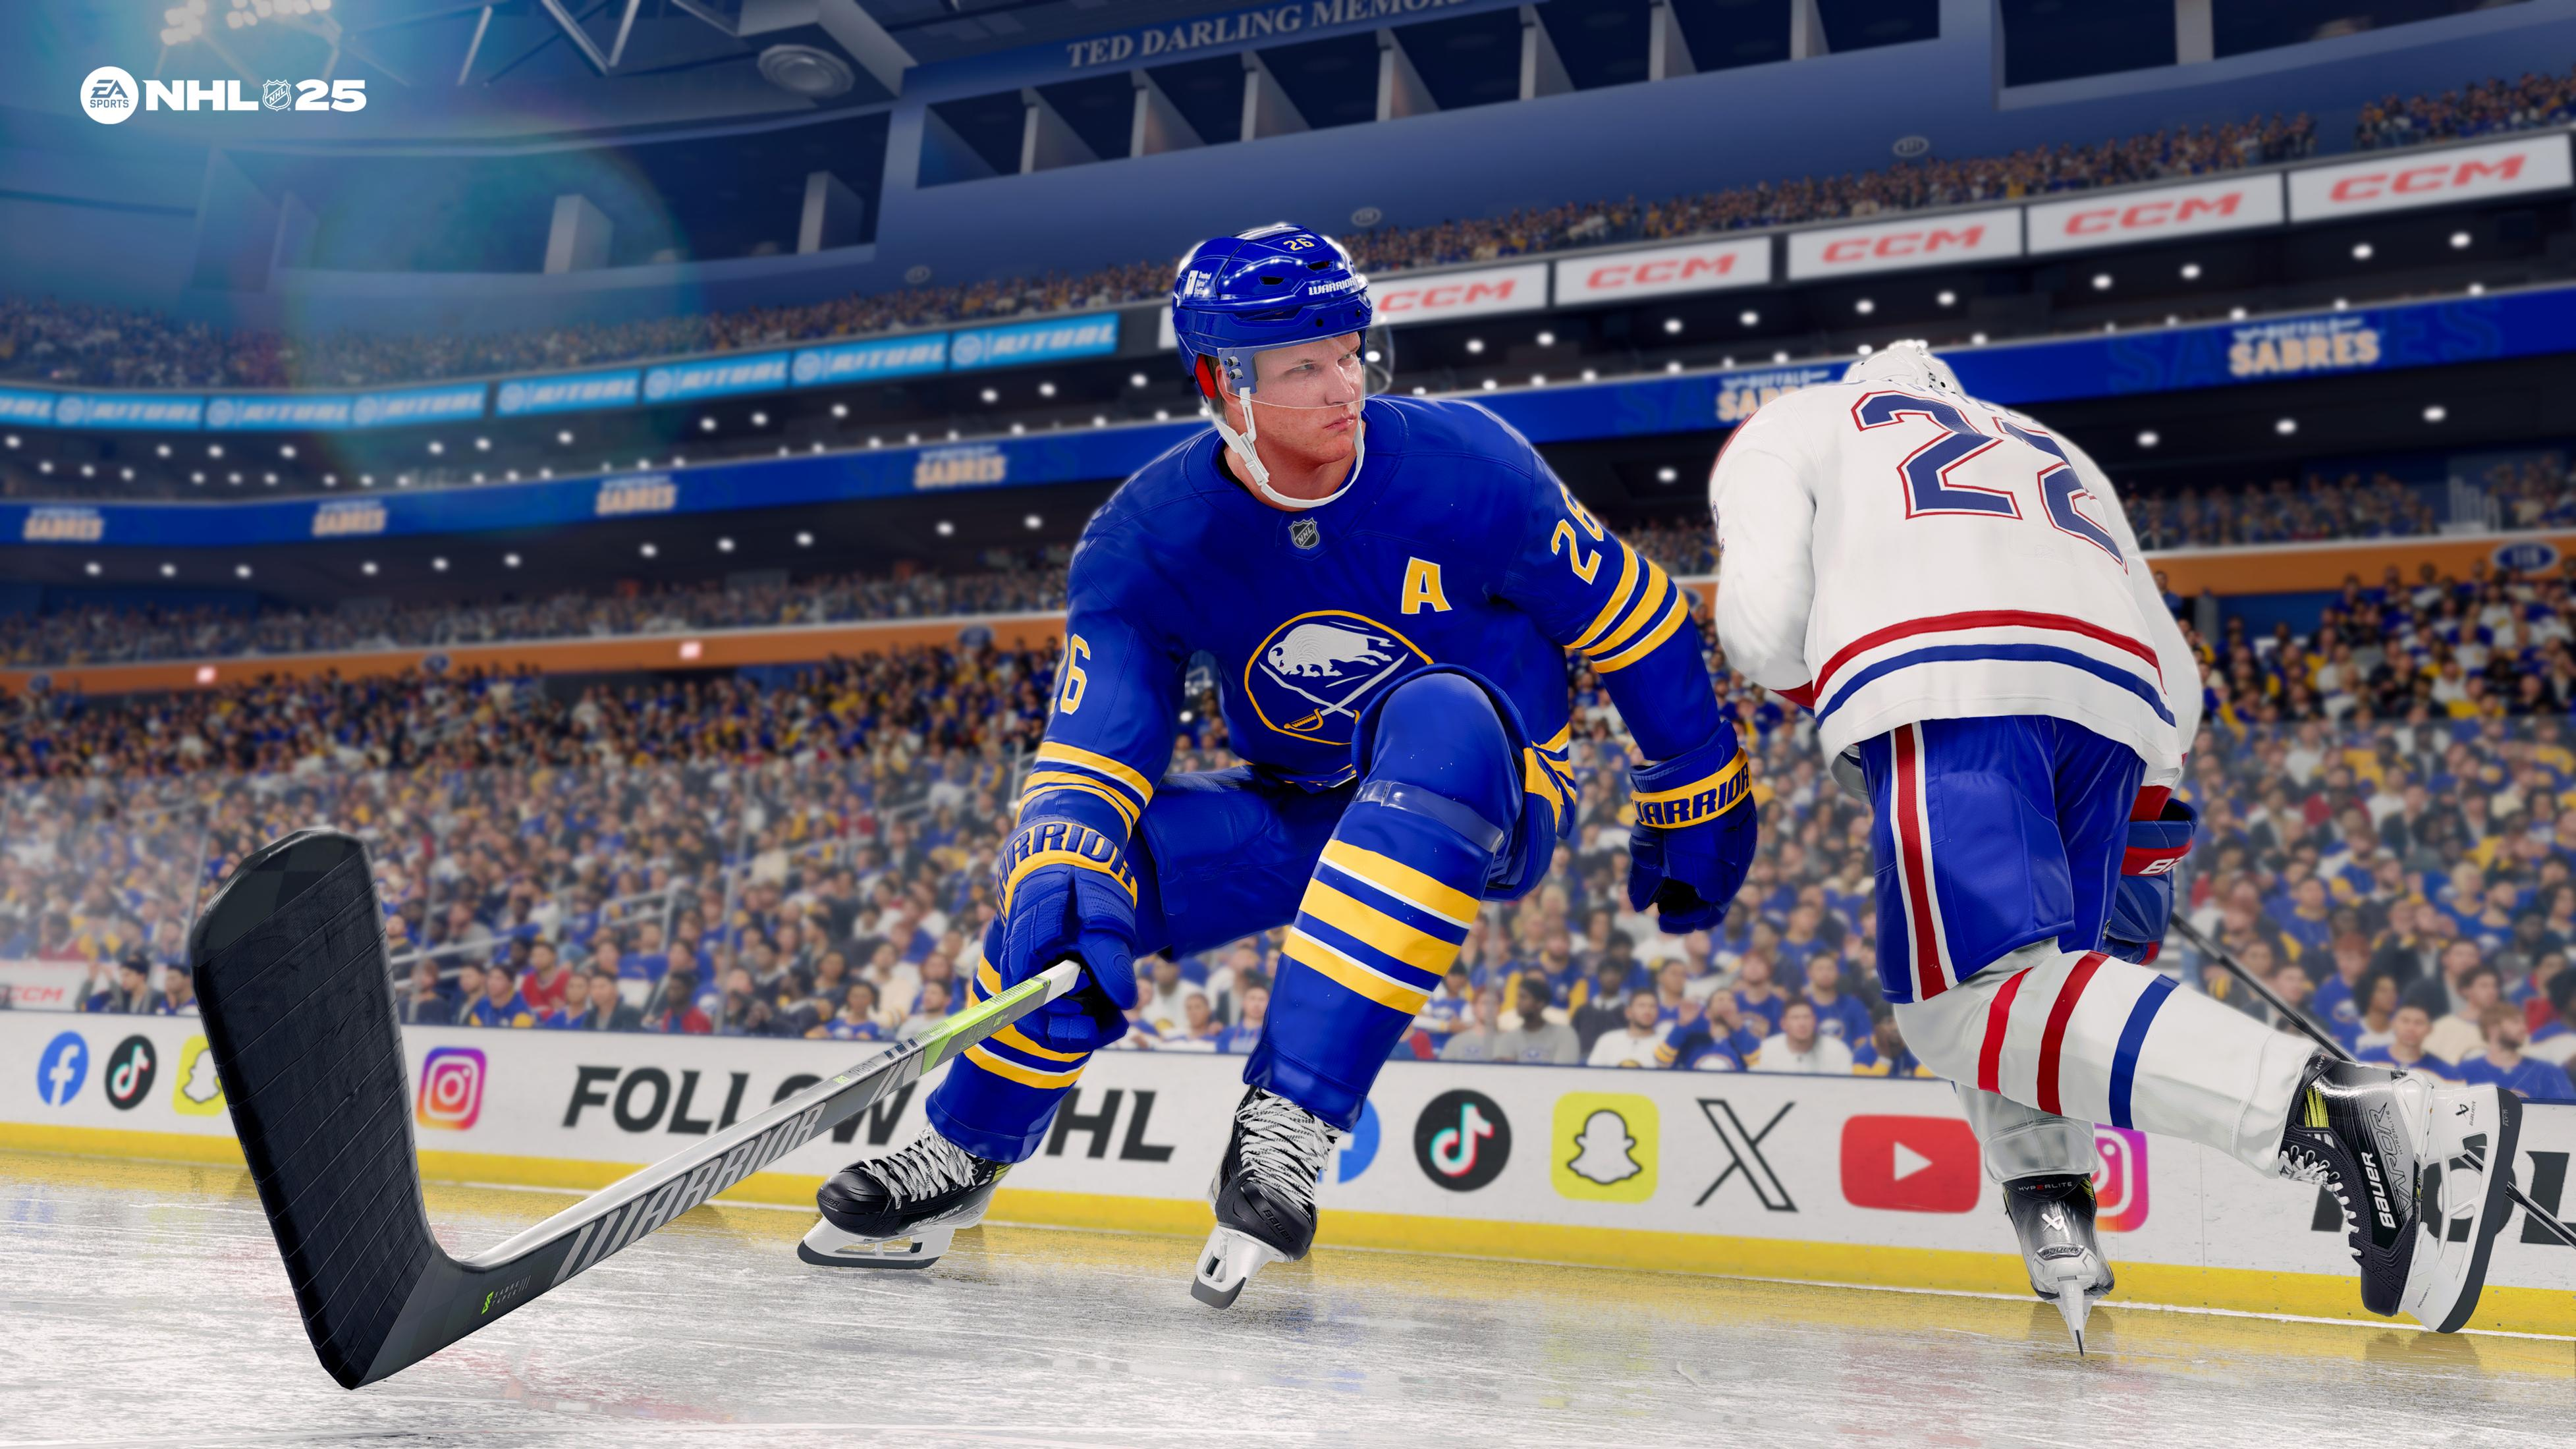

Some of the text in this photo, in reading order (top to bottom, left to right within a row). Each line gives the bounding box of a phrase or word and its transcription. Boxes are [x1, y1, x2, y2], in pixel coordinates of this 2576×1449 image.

[1066, 36, 1134, 68] TED
[1139, 5, 1302, 57] DARLING
[2329, 154, 2526, 202] CCM
[2064, 192, 2243, 237] CCM
[1282, 237, 1315, 252] 26
[1821, 225, 1985, 264] CCM
[1308, 277, 1357, 296] WARRIOR
[1586, 253, 1738, 290] CCM
[1377, 279, 1516, 313] CCM
[2228, 329, 2380, 377] SABRES
[1851, 389, 2129, 576] 22
[1550, 483, 1604, 586] 26
[1401, 556, 1452, 615] A
[997, 823, 1134, 925] ARRIOR
[1045, 1087, 1176, 1163] HL
[549, 1102, 827, 1288] WARRIOR
[2361, 1151, 2397, 1230] BAUER
[1263, 1209, 1294, 1244] BAUER
